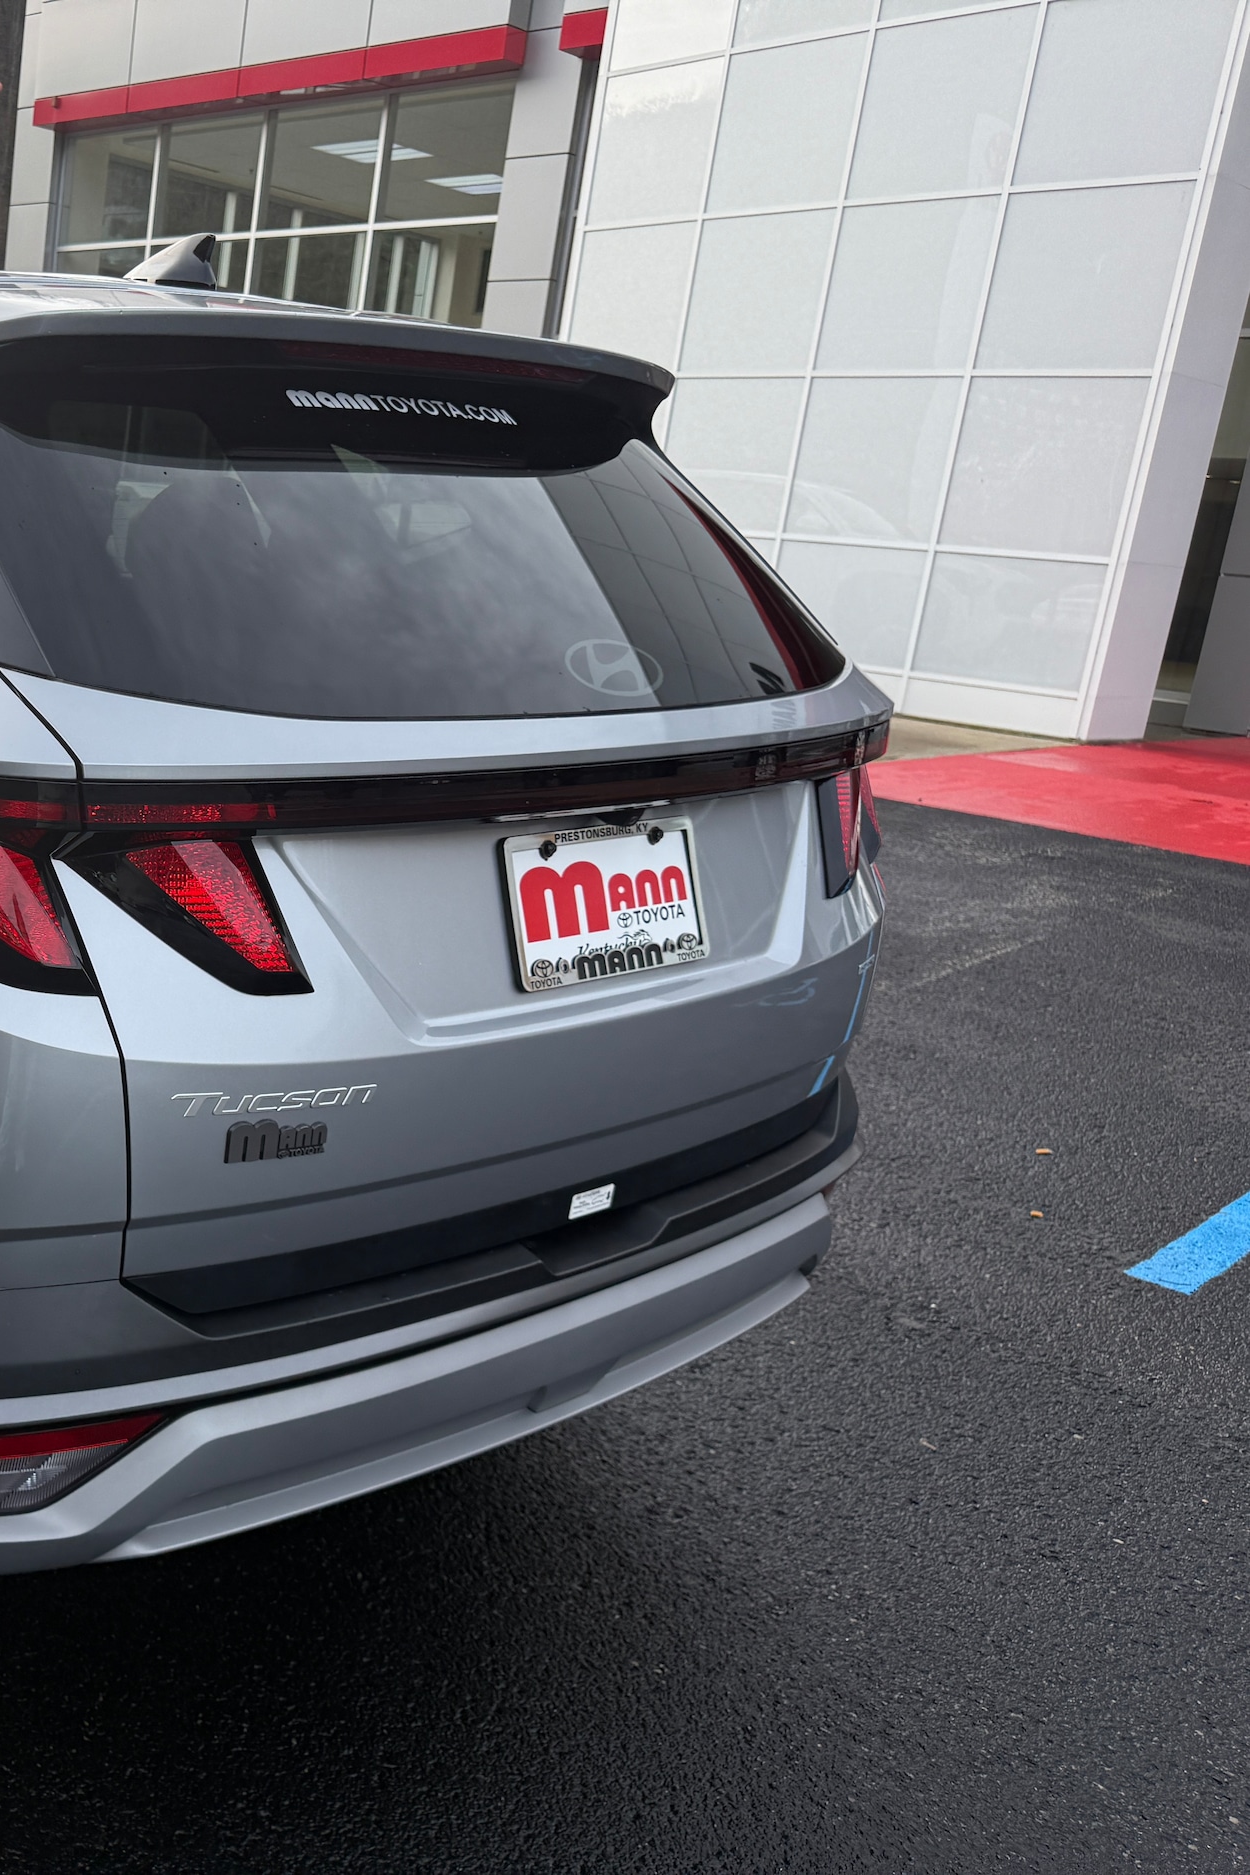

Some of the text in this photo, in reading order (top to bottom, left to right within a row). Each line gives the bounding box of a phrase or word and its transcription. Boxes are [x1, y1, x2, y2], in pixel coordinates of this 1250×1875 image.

[635, 822, 648, 834] KY
[634, 904, 686, 926] TOYOTA
[677, 949, 706, 963] TOYOTA
[530, 976, 563, 991] TOYOTA
[289, 1145, 325, 1158] TOYOTA
